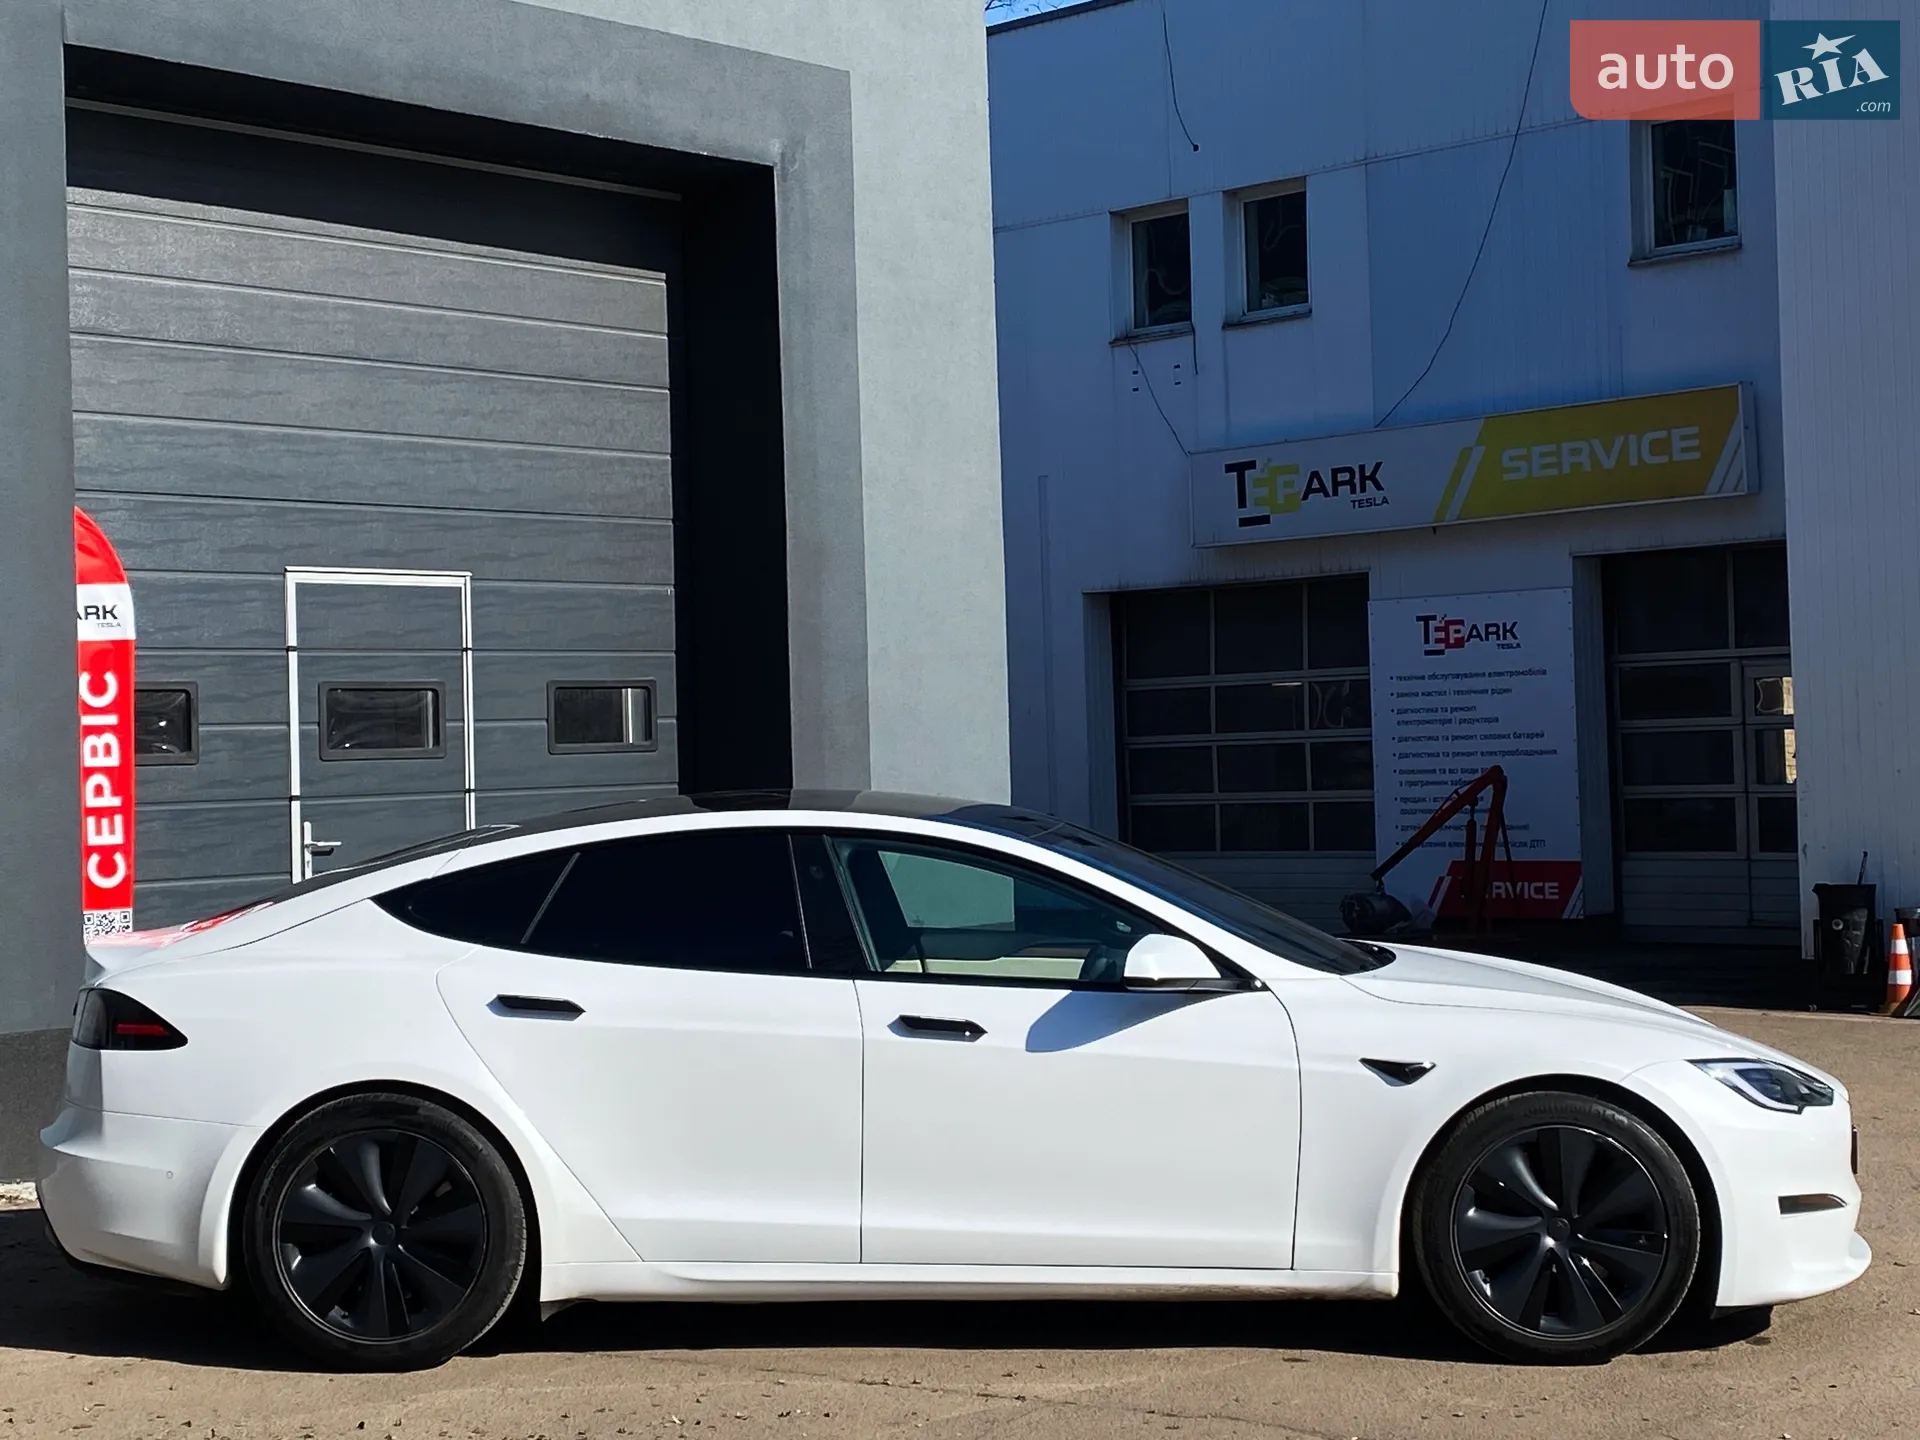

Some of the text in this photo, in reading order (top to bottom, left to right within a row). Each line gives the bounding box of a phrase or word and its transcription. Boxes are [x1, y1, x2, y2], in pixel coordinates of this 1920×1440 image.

[1502, 425, 1701, 482] SERVICE
[1349, 495, 1390, 510] TESLA
[1496, 642, 1522, 651] TESLA
[1440, 706, 1449, 714] та
[1441, 734, 1450, 742] та
[78, 671, 127, 890] СЕРВІС
[1484, 881, 1559, 899] RVICE
